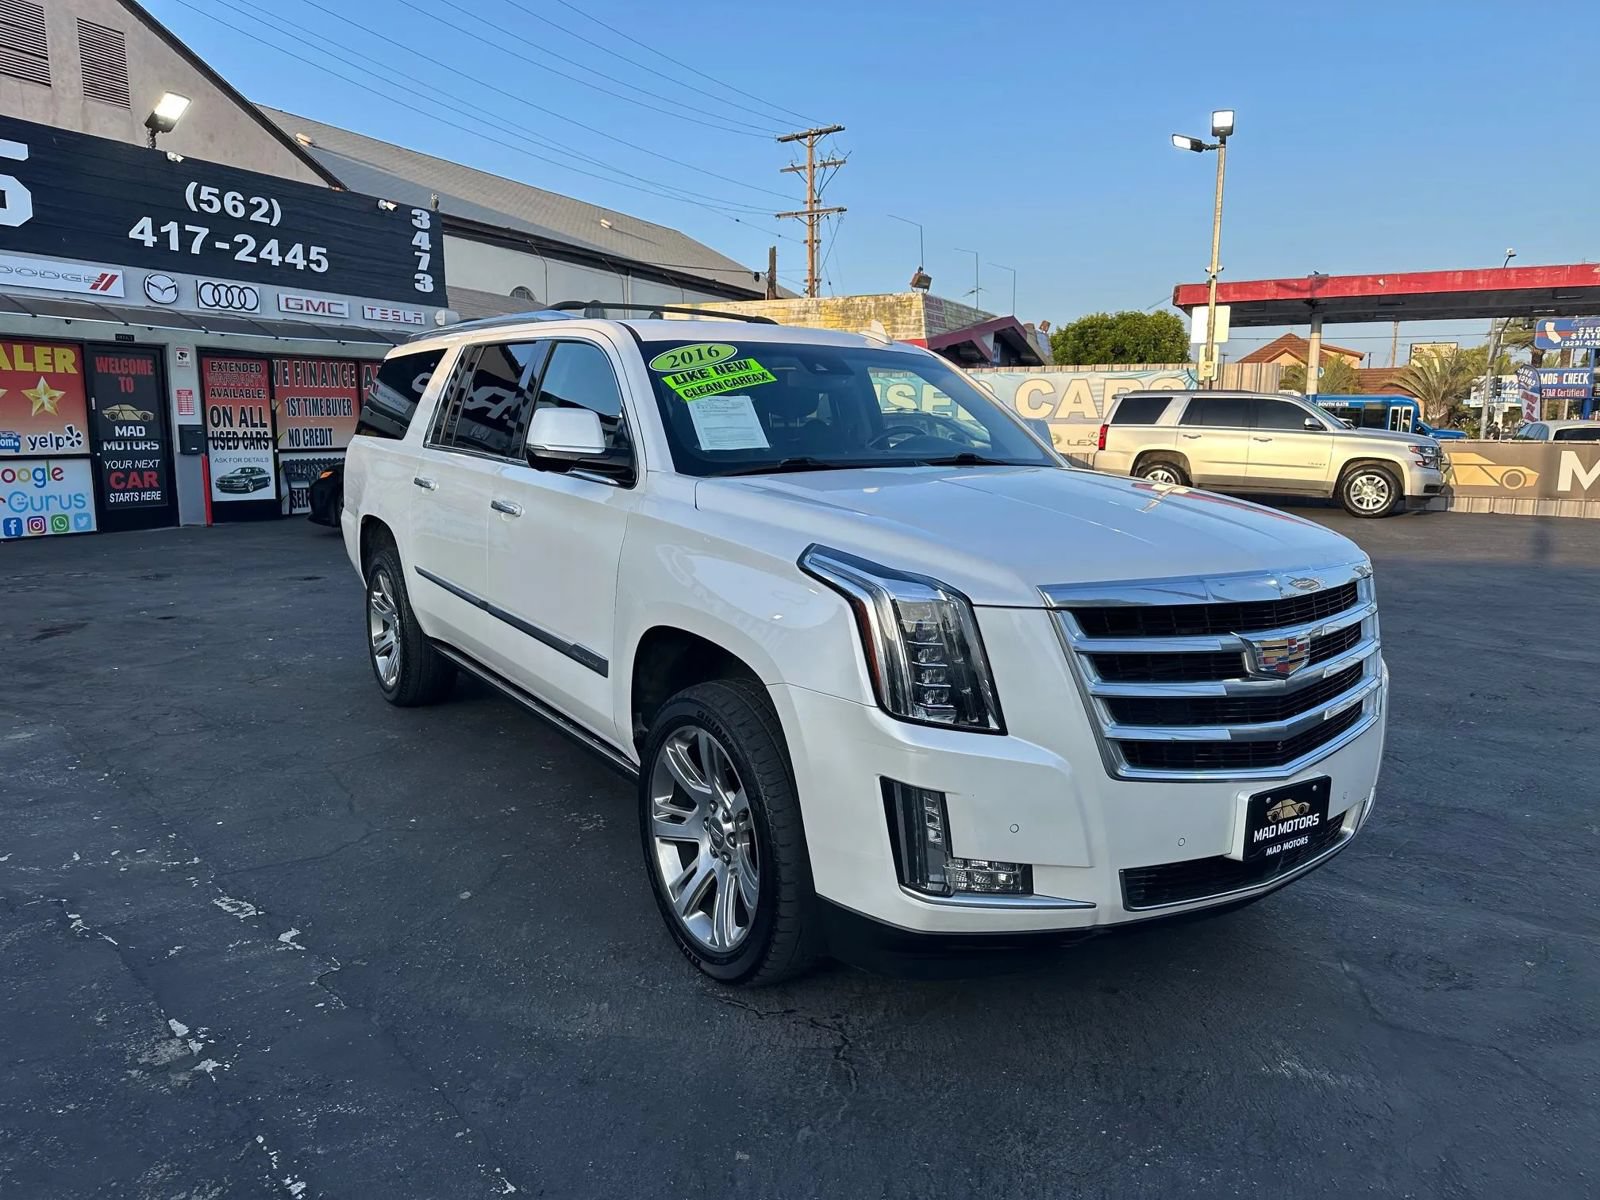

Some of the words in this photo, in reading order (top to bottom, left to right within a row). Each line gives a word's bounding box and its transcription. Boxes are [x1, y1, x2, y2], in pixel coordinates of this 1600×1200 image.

[185, 182, 282, 227] (562)
[128, 216, 329, 273] 417-2445
[411, 208, 434, 293] 3473
[285, 297, 345, 315] GMC
[366, 307, 423, 325] TESLA
[96, 356, 154, 375] WELCOME
[666, 345, 720, 368] 2016
[211, 361, 262, 374] EXTENDED
[293, 360, 356, 388] FINANCE
[672, 367, 713, 386] LIKE
[714, 360, 752, 376] NEW
[118, 376, 134, 393] TO
[683, 381, 725, 398] CLEAN
[725, 372, 768, 389] CARFAX
[1563, 373, 1589, 385] CHECK
[210, 406, 234, 428] ON
[238, 406, 267, 428] ALL
[286, 398, 301, 417] 1ST
[302, 398, 326, 417] TIME
[326, 398, 352, 417] BUYER
[28, 432, 65, 450] yelp
[114, 426, 146, 437] MAD
[211, 431, 240, 451] USED
[241, 431, 269, 450] CARS
[288, 428, 301, 447] NO
[302, 428, 333, 447] CREDIT
[103, 441, 159, 451] MOTORS
[105, 460, 132, 470] YOUR
[135, 459, 160, 469] NEXT
[109, 471, 159, 490] CAR
[109, 492, 139, 503] STARTS
[141, 491, 161, 501] HERE
[1254, 824, 1276, 843] MAD
[1278, 813, 1320, 835] MOTORS
[1266, 845, 1281, 856] MAD
[1282, 836, 1309, 851] MOTORS
